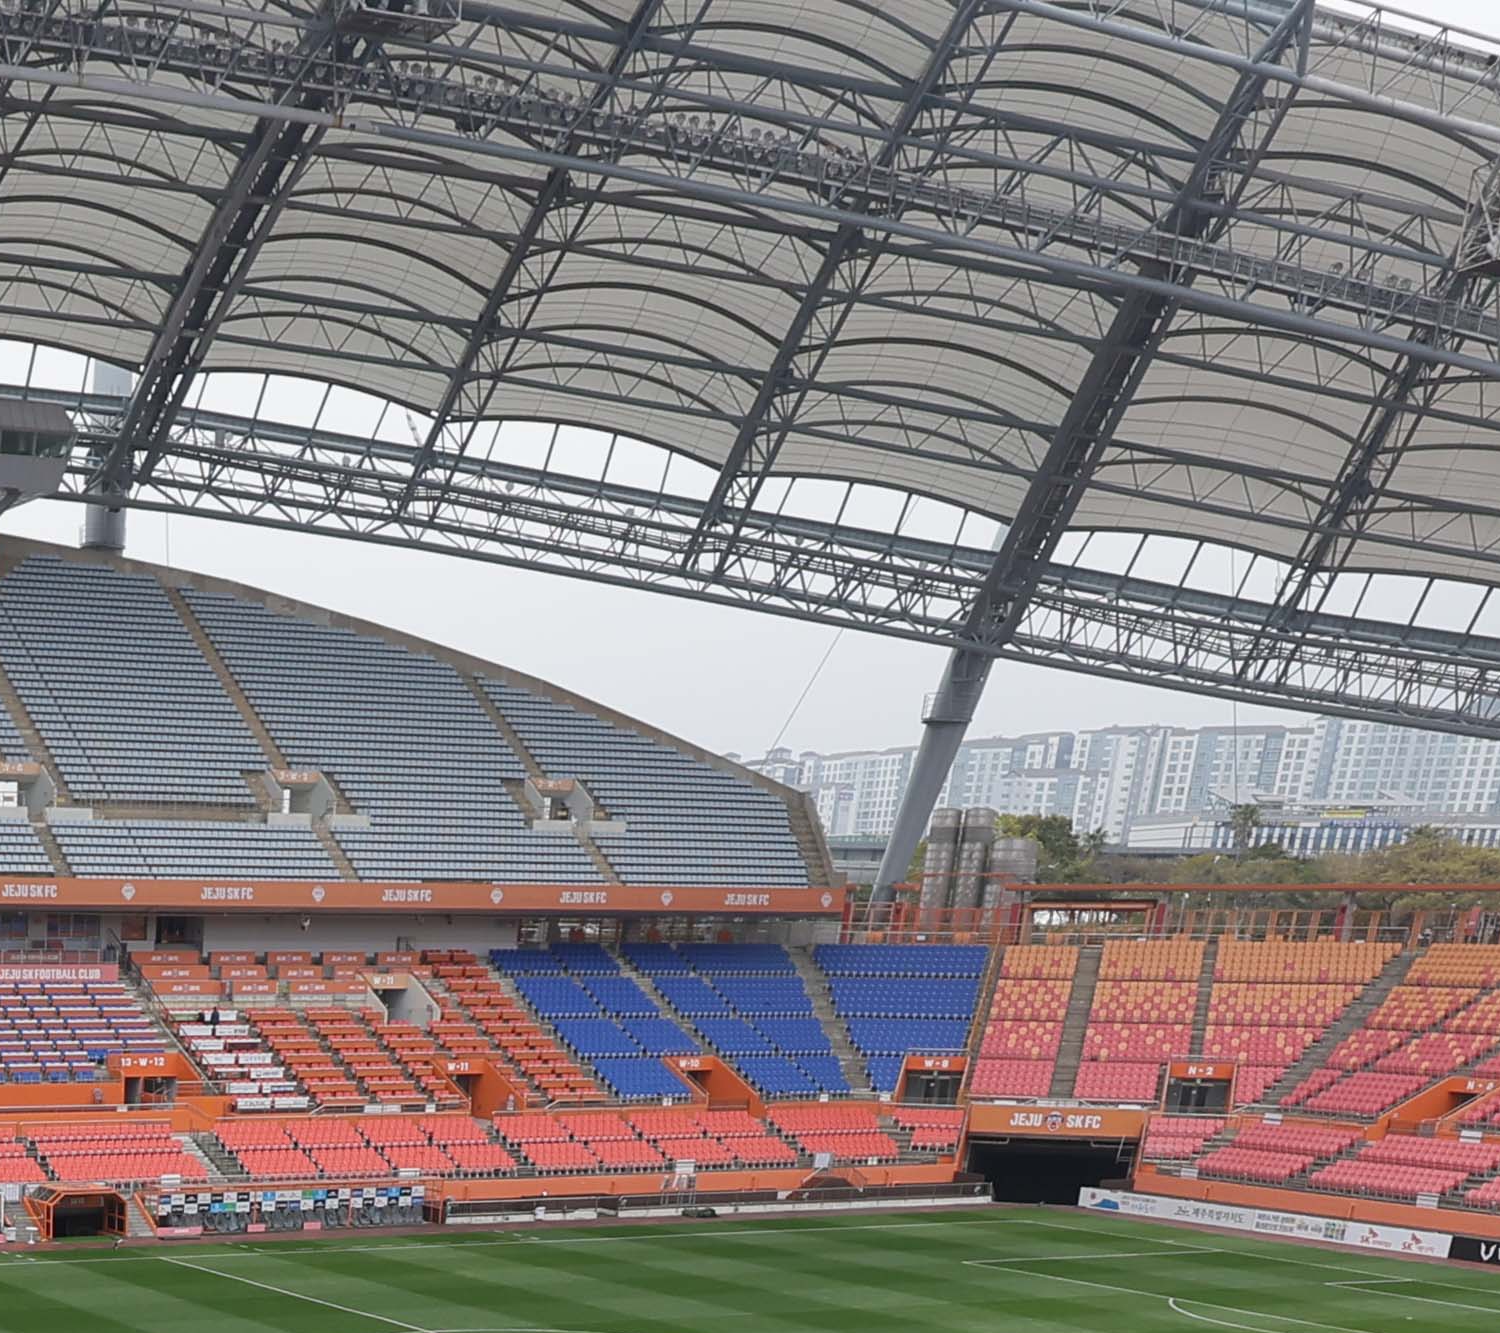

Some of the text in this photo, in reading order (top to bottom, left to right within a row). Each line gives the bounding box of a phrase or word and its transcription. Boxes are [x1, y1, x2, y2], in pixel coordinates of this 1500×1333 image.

[0, 968, 21, 980] JEJU
[35, 968, 76, 980] FOOTBALL
[77, 968, 100, 980] CLUB
[1010, 1112, 1101, 1129] JEJU SK FC
